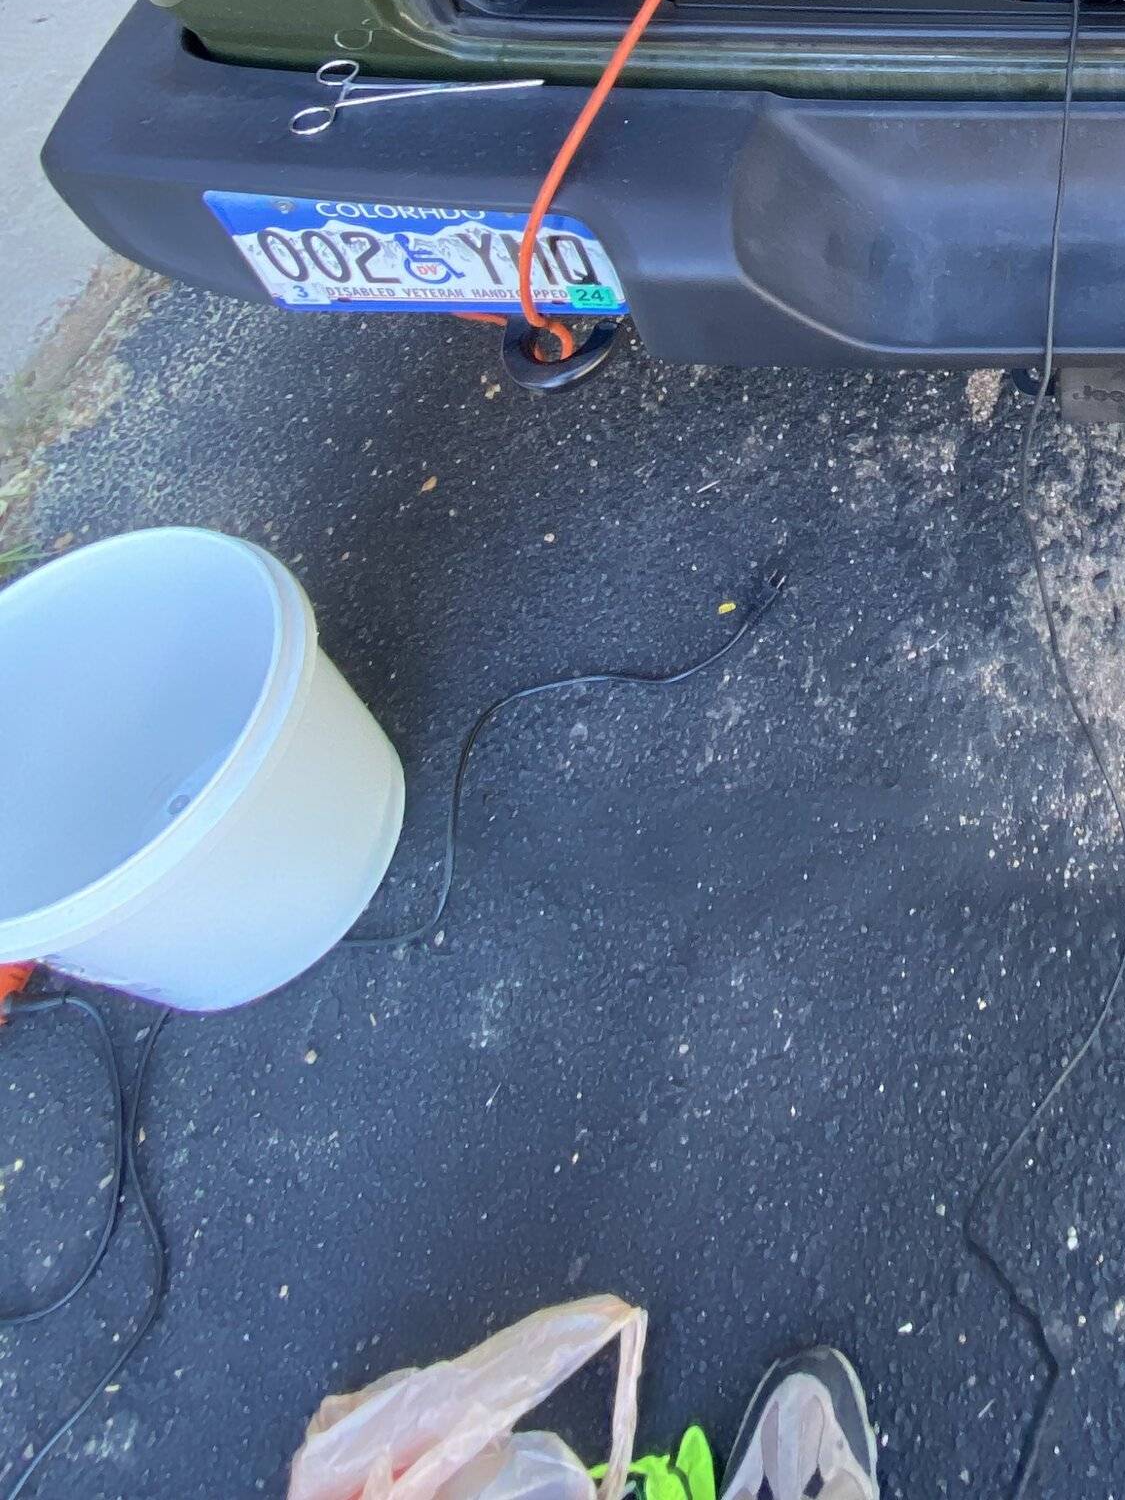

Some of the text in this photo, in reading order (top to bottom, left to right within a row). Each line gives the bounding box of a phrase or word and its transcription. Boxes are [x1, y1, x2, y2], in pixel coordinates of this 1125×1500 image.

[256, 229, 402, 284] 002
[416, 264, 438, 276] DV
[292, 285, 309, 299] 3
[326, 286, 568, 299] DISABLED VETERAN HANDICPPED
[575, 288, 605, 302] 24
